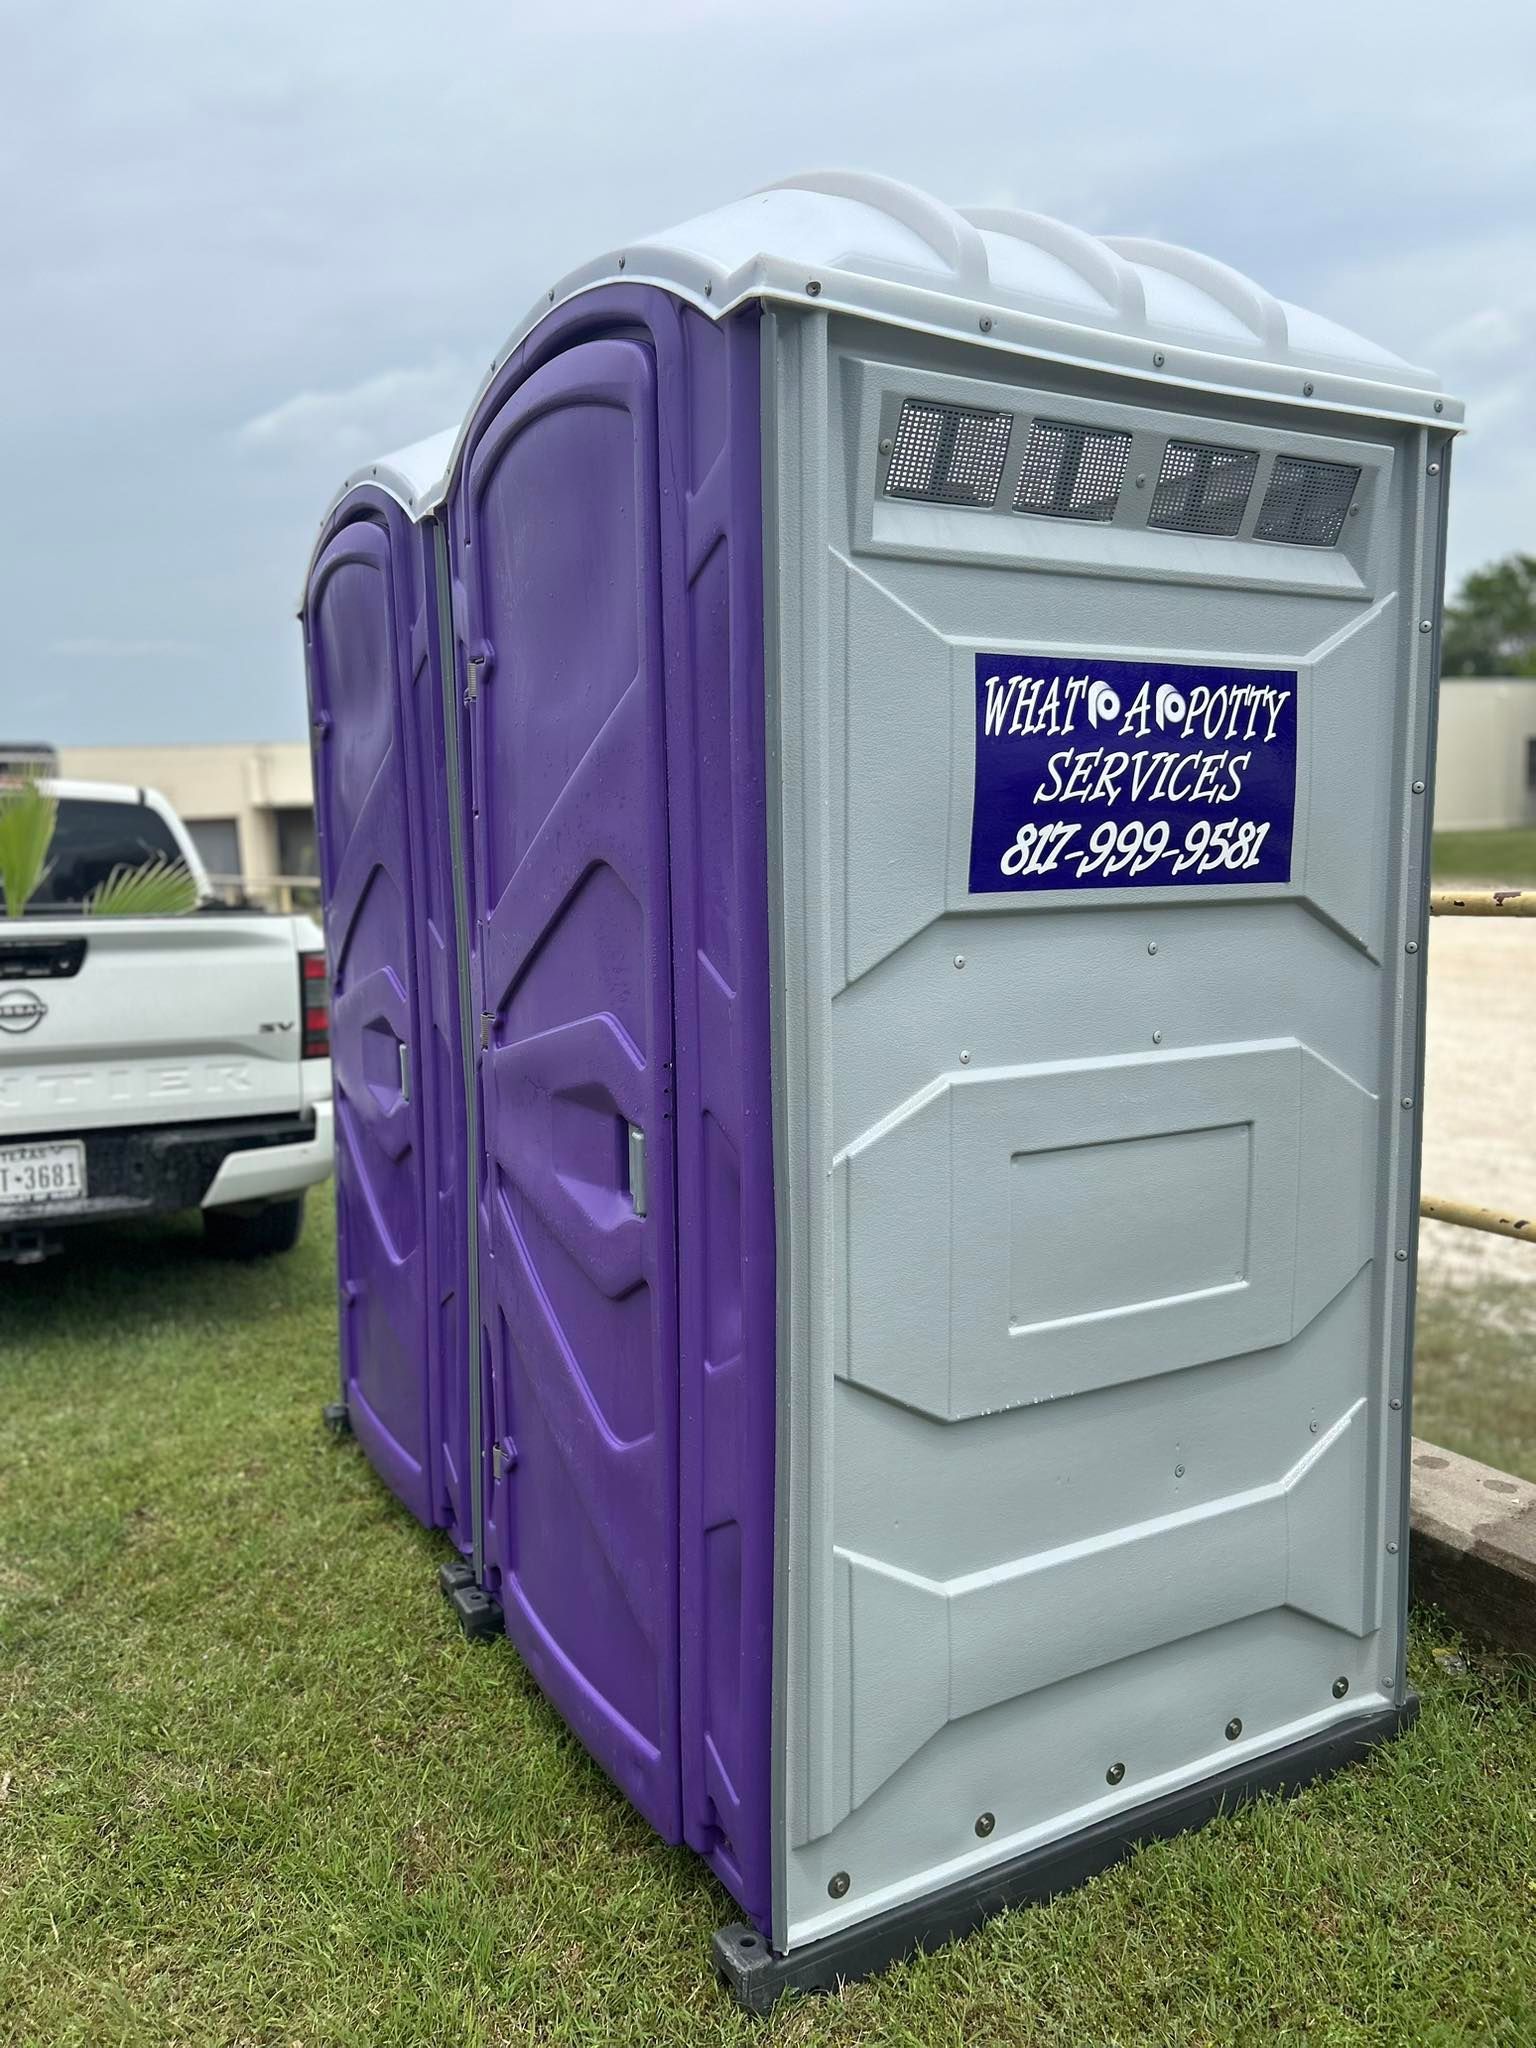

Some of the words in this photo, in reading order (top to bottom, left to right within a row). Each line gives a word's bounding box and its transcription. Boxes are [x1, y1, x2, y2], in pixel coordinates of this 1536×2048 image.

[985, 675, 1089, 736] WHAT
[1118, 680, 1151, 738] A
[1180, 683, 1291, 742] POTTY
[1033, 747, 1251, 806] SERVICES
[1000, 819, 1271, 878] 817-999-9581
[259, 1021, 295, 1033] SV
